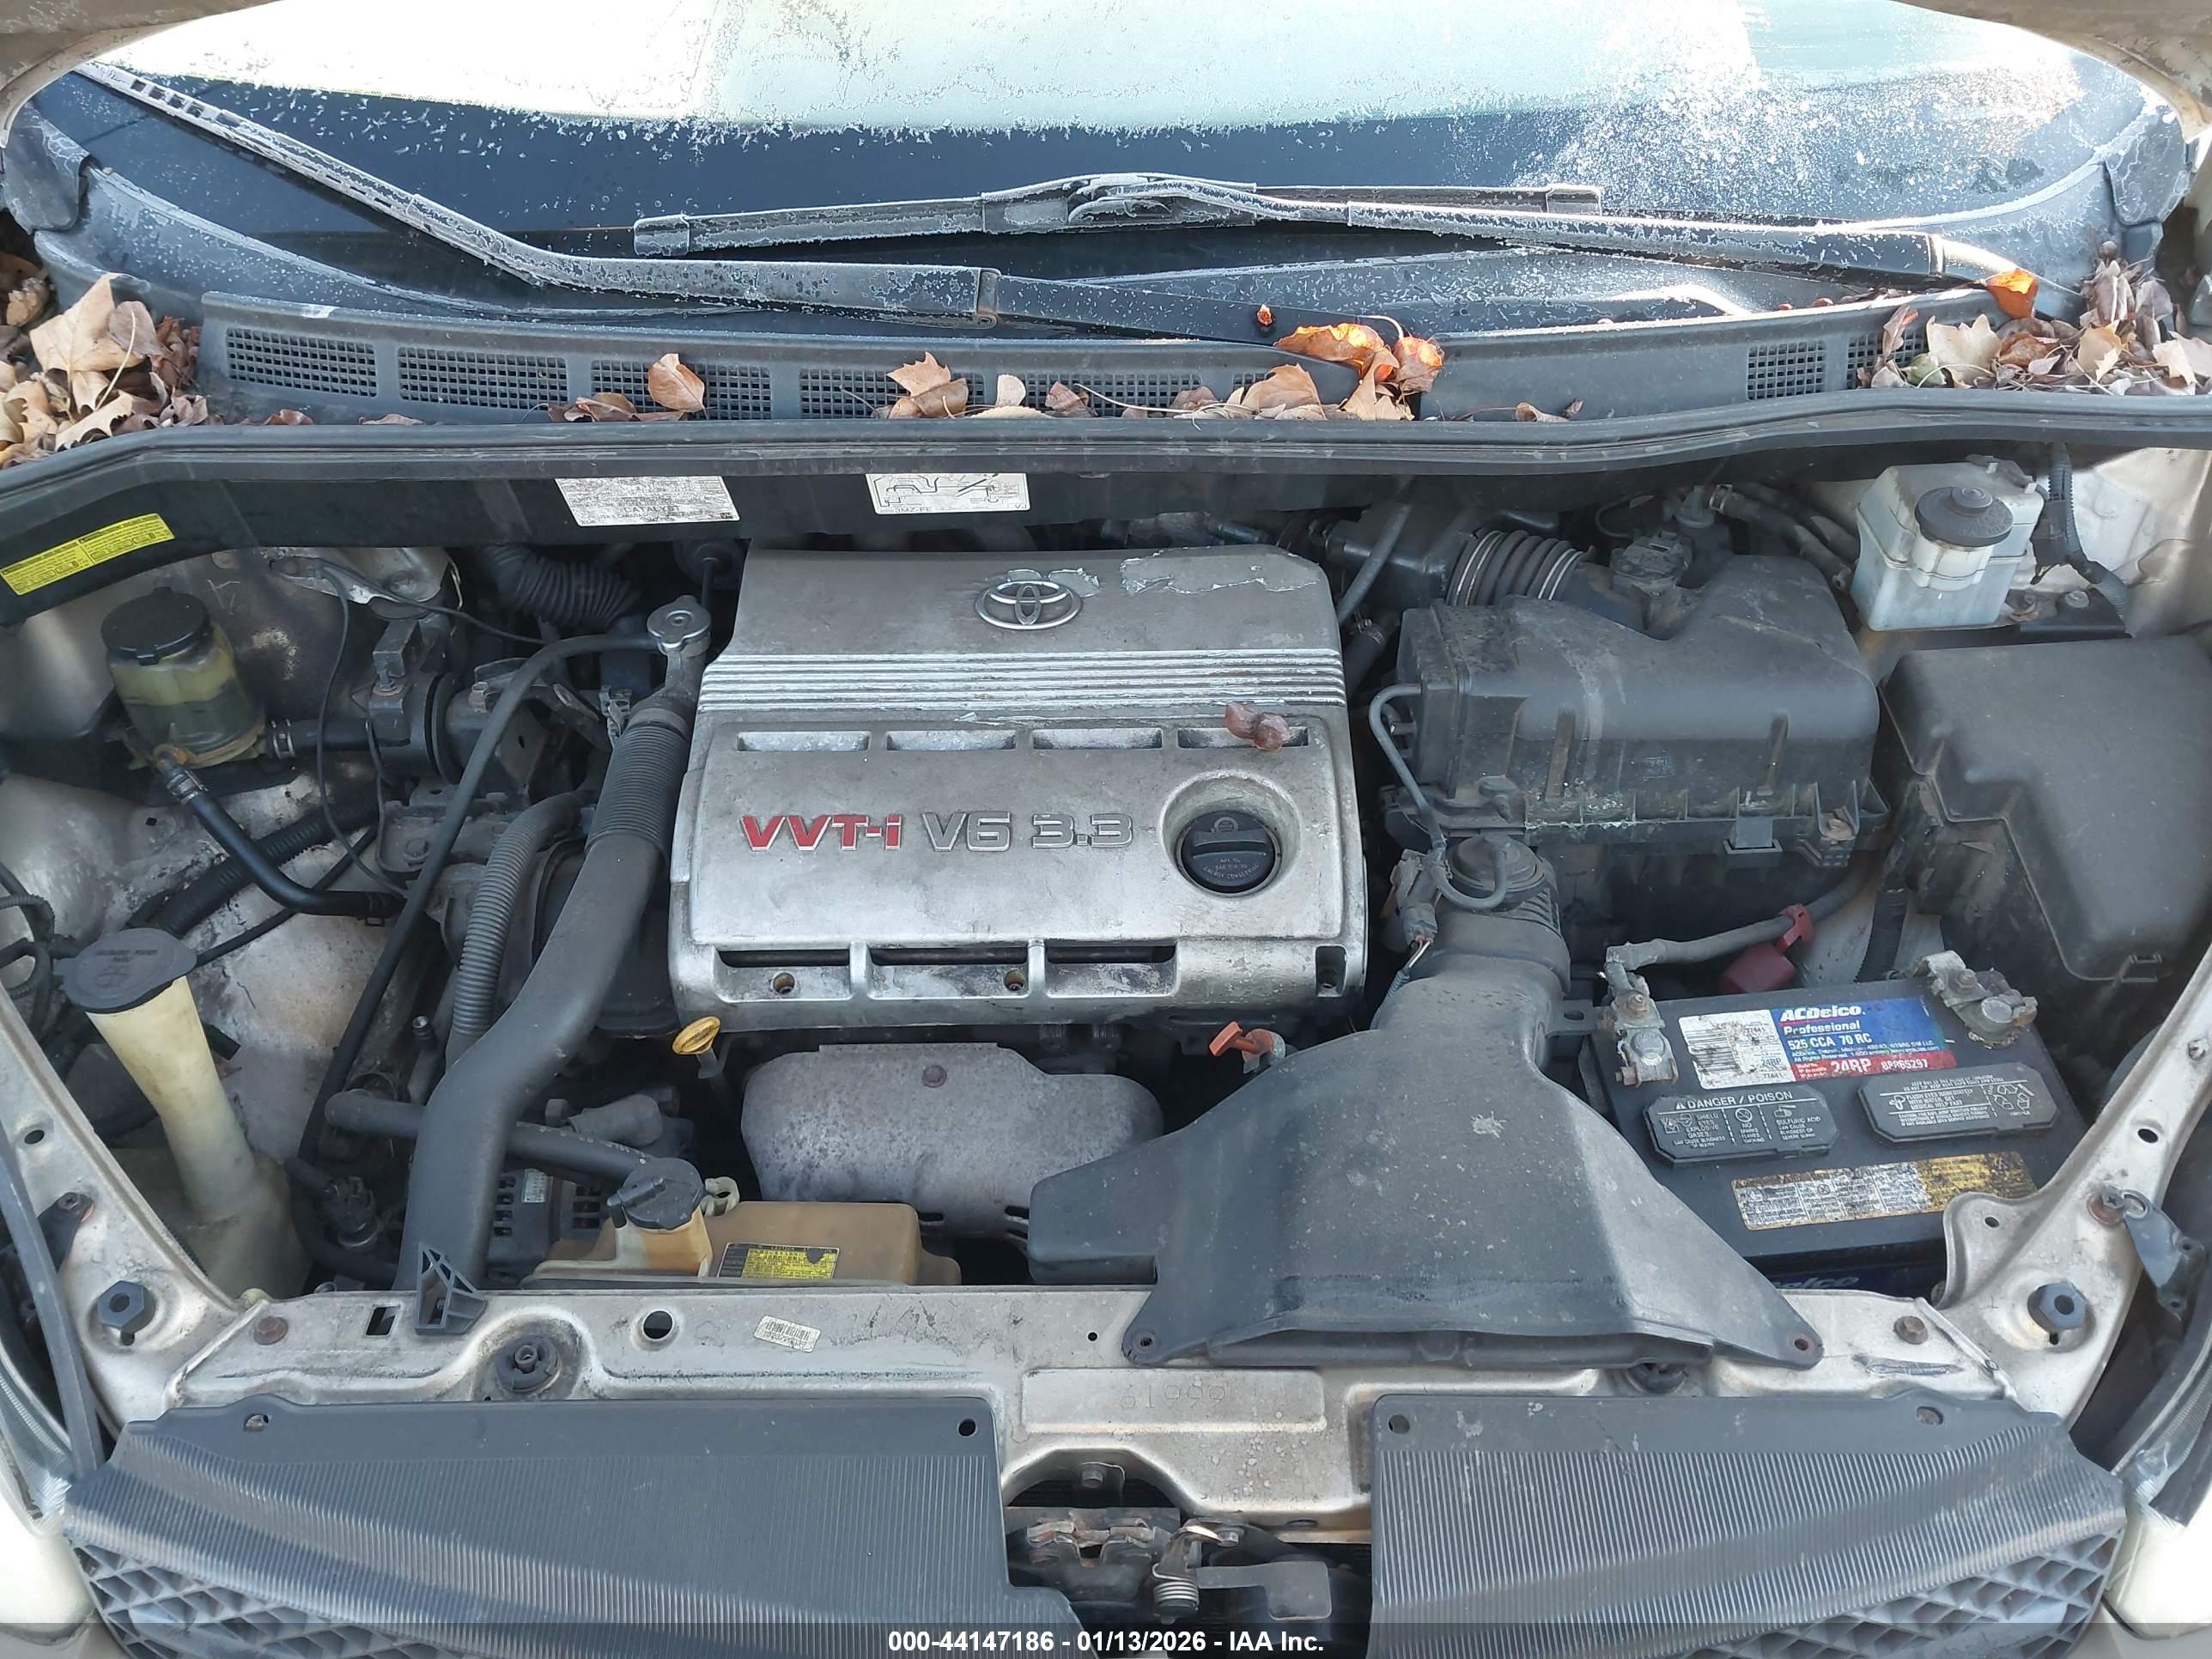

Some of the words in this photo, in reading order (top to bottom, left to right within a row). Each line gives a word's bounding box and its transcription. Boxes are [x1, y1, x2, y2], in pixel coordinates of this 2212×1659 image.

[742, 814, 905, 851] VVT-i
[921, 811, 1012, 851] V6
[1031, 813, 1134, 849] 3.3
[1780, 1005, 1863, 1022] ACDelco
[1784, 1020, 1861, 1036] Professional
[1787, 1039, 1808, 1051] 525
[1809, 1036, 1835, 1048] CCA
[1839, 1034, 1853, 1045] 70
[1855, 1033, 1872, 1044] RC
[1687, 1097, 1736, 1109] DANGER
[1747, 1091, 1793, 1103] POISON
[1686, 1124, 1719, 1133] EXPLOSIVE
